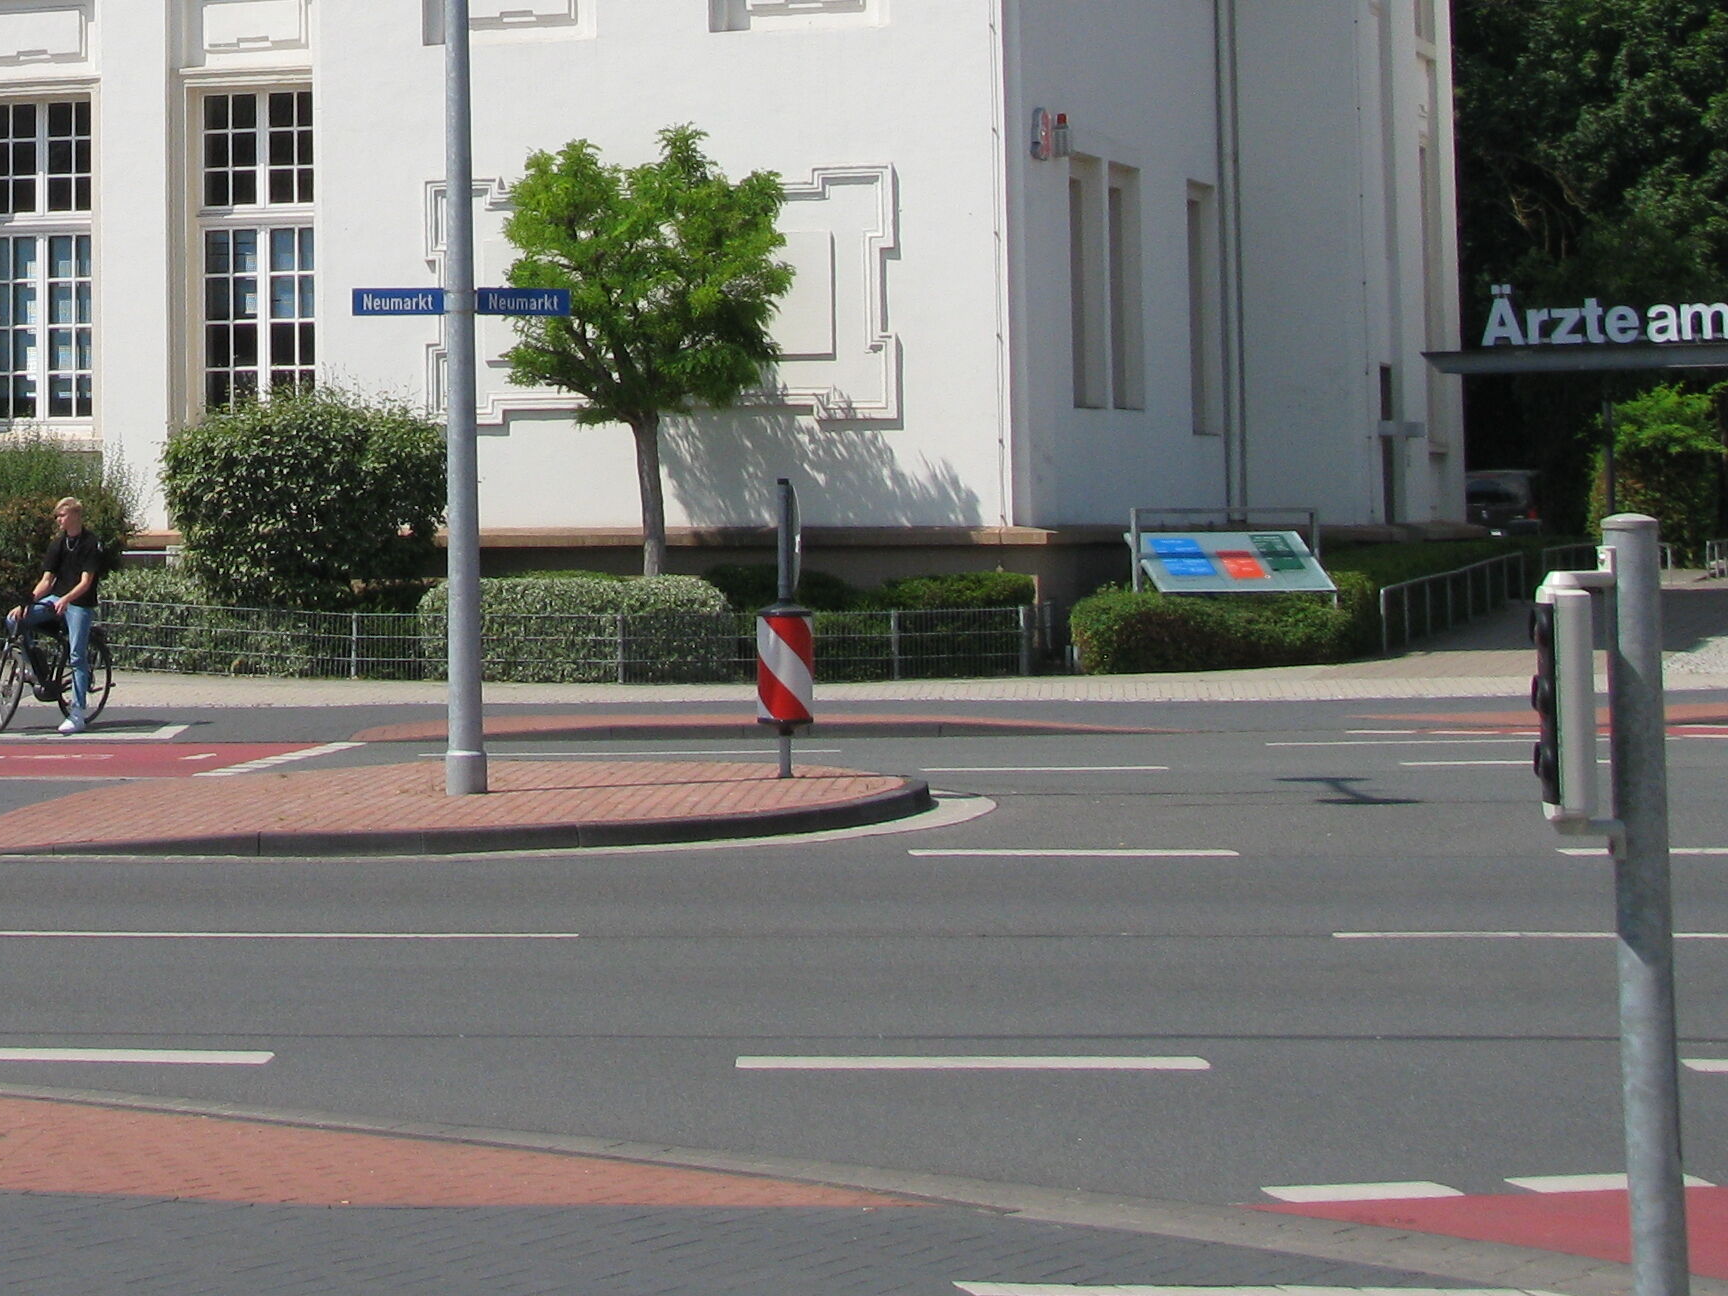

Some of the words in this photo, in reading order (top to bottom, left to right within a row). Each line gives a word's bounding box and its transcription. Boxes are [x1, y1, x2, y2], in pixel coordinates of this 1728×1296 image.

[363, 293, 434, 311] Neumarkt
[488, 293, 559, 311] Neumarkt
[1481, 284, 1640, 346] Ärzte
[1646, 302, 1728, 343] am
